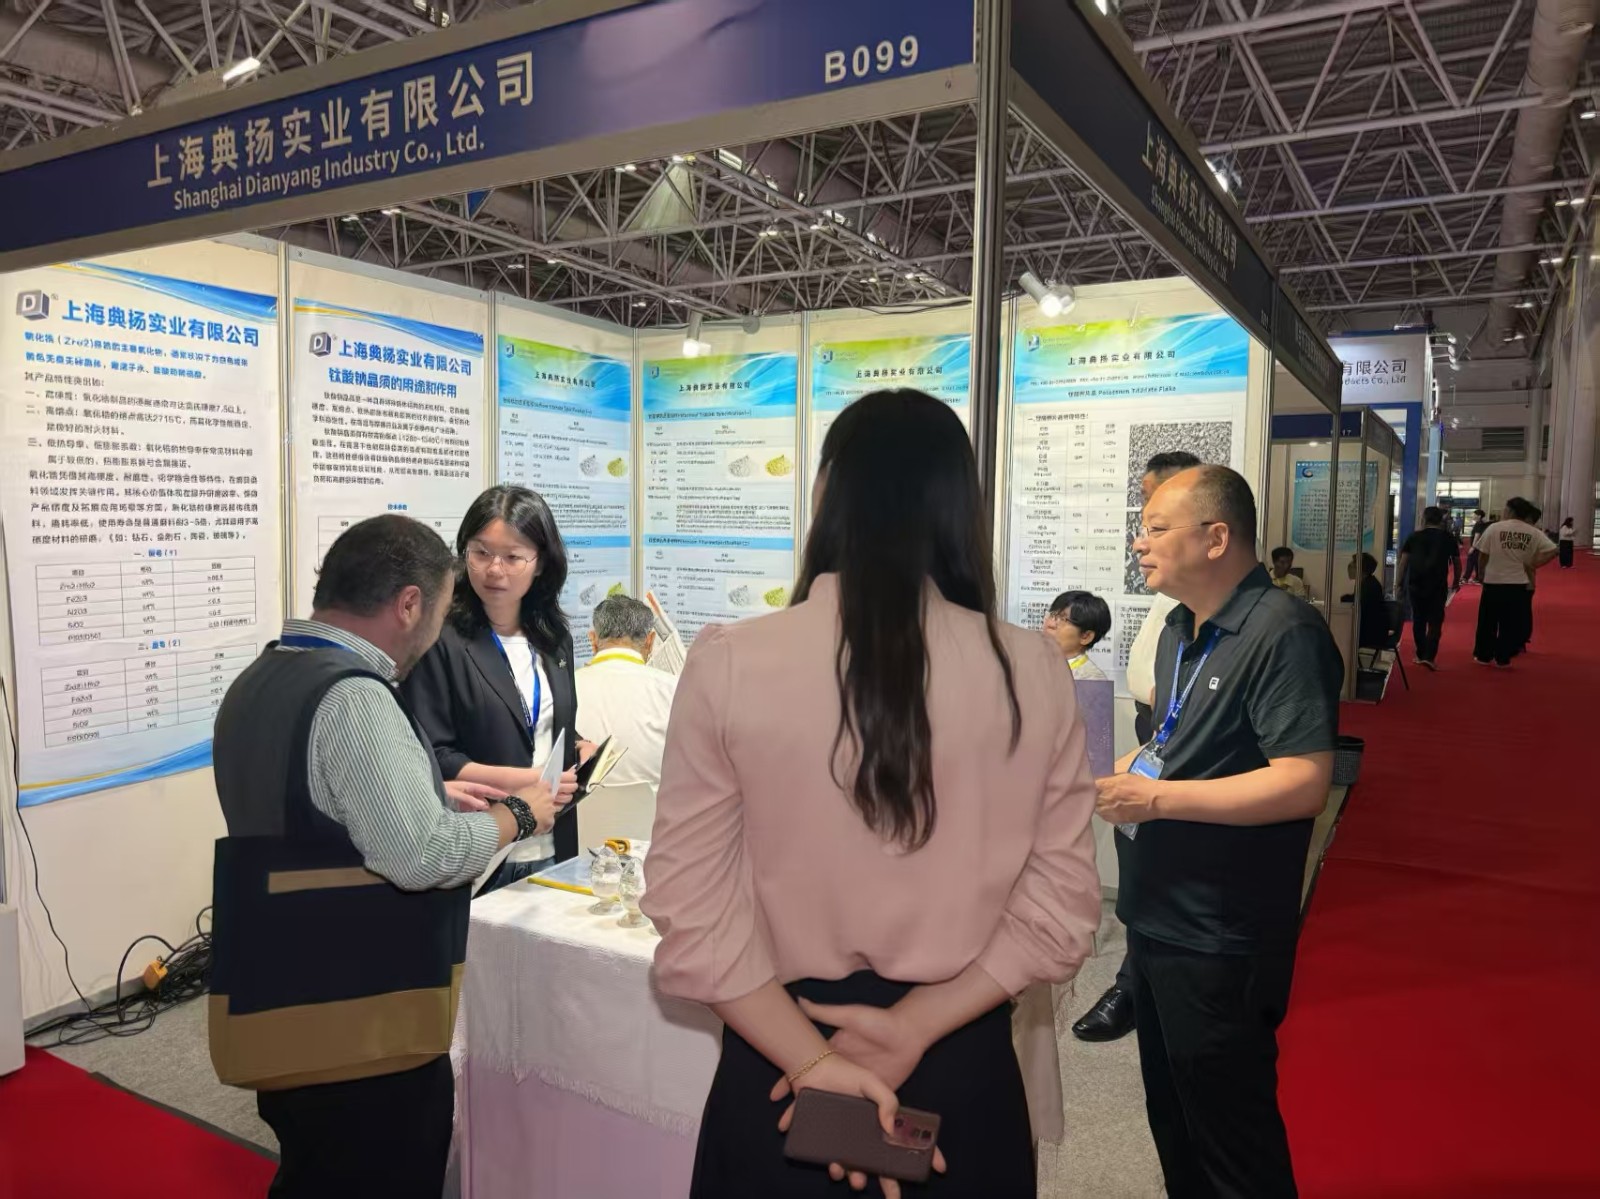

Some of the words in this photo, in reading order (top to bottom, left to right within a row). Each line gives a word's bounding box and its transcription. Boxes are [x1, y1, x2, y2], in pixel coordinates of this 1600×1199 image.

[825, 35, 919, 84] B099
[147, 51, 534, 189] 上海典扬实业有限公司
[174, 178, 242, 211] Shanghai
[246, 165, 321, 196] Dianyang
[325, 149, 401, 181] Industry
[405, 137, 442, 164] Co.,
[446, 125, 485, 154] Ltd.
[1142, 120, 1237, 270] 上海典扬实业有限公司
[62, 299, 259, 347] 上海典扬实业有限公司
[338, 340, 472, 376] 上海典扬实业有限公司
[1067, 350, 1177, 366] 上海典扬实业有限公司
[1343, 360, 1407, 376] 有限公司
[328, 367, 457, 398] 钛酸钠晶须的用途和作用
